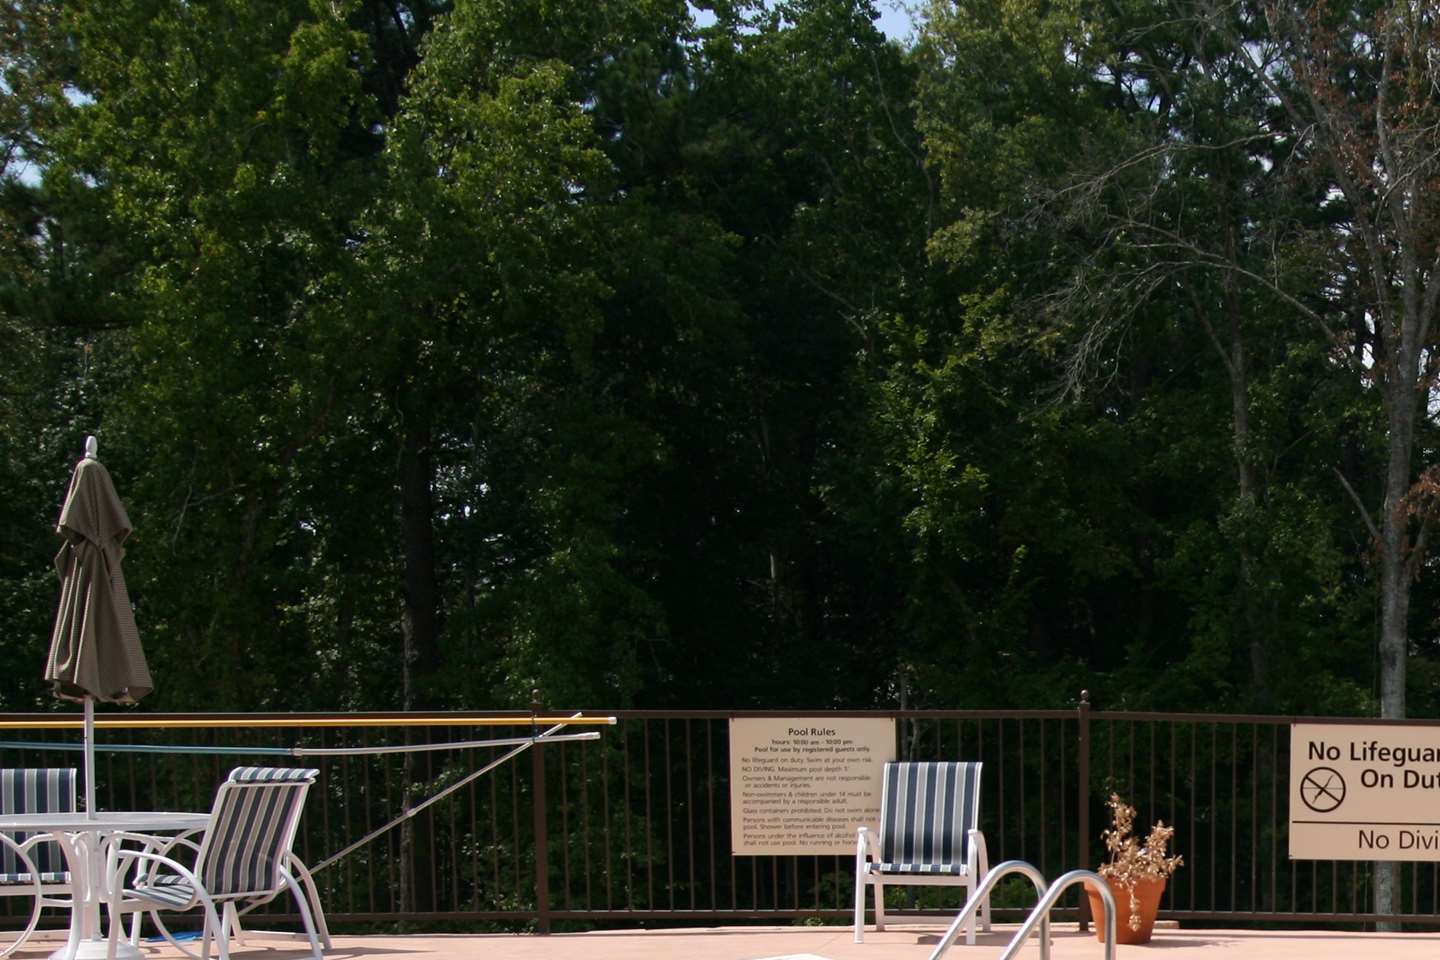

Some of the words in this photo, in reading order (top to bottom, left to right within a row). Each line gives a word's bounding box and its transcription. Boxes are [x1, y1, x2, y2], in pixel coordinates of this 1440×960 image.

[788, 728, 808, 736] Pool
[811, 728, 836, 736] Rules
[1308, 741, 1341, 761] No
[773, 775, 813, 783] Management
[1361, 769, 1394, 788] On
[1359, 830, 1389, 849] No
